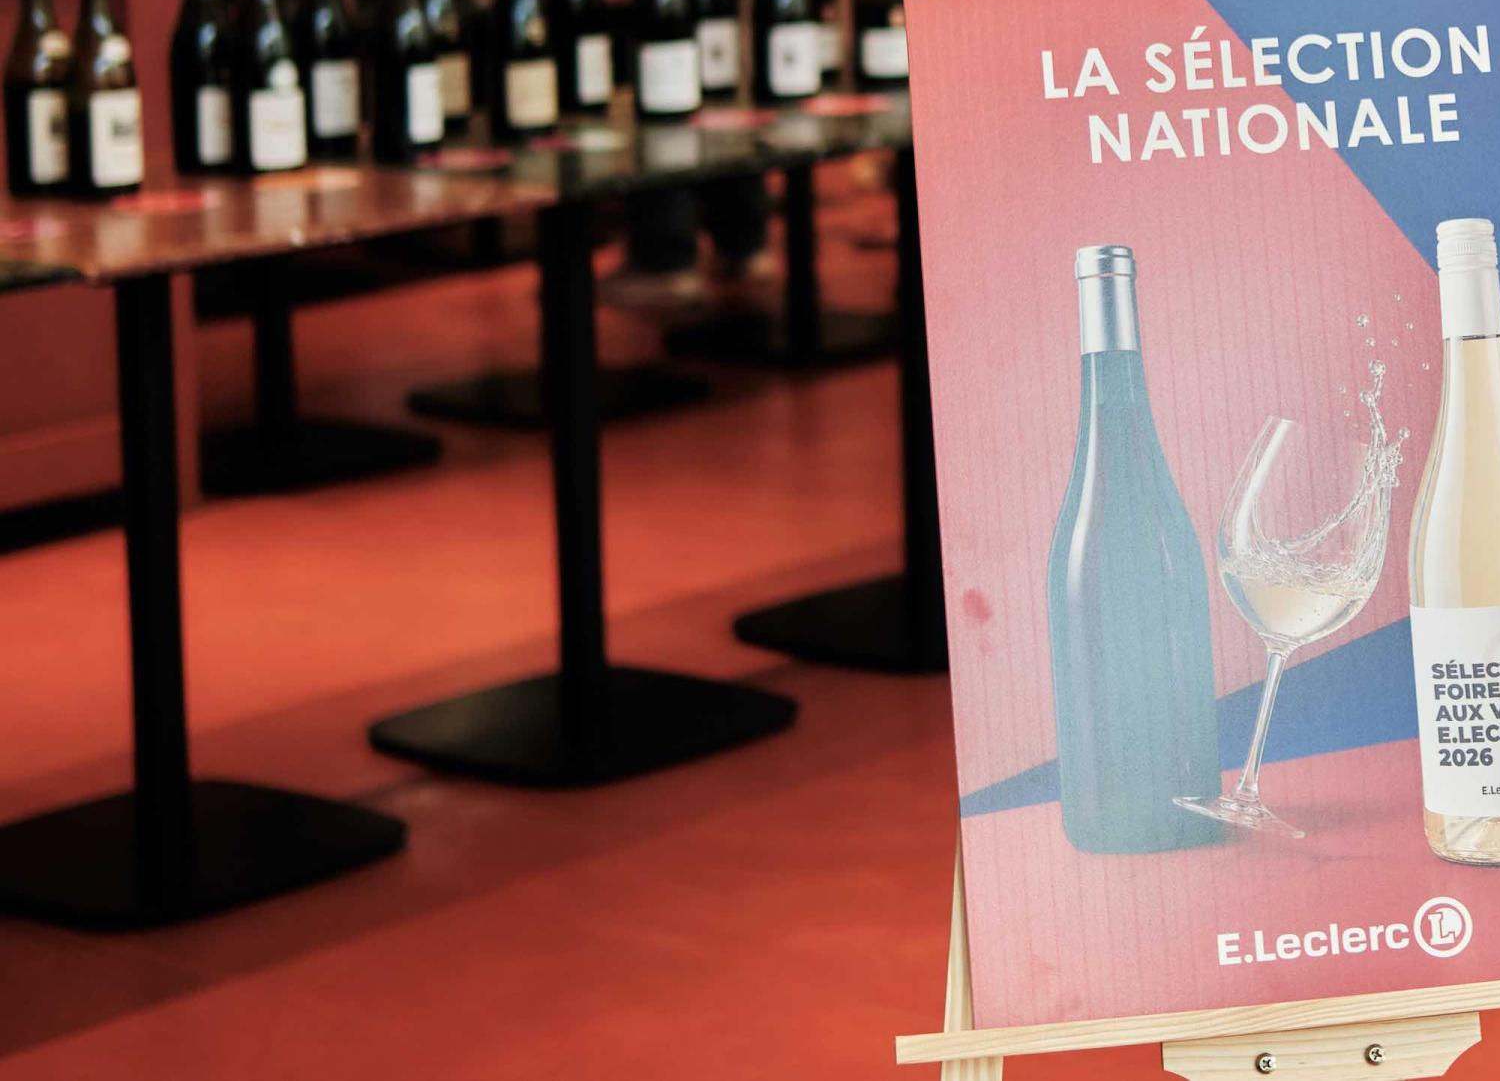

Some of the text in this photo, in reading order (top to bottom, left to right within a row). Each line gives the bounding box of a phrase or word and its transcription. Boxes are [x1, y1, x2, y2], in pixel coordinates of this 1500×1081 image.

[1042, 25, 1492, 99] LA SÉLECTION
[1089, 93, 1460, 164] NATIONALE
[1433, 682, 1500, 700] FOIRE
[1436, 704, 1484, 722] AUX
[1438, 747, 1494, 767] 2026
[1217, 923, 1410, 966] E.Leclerc
